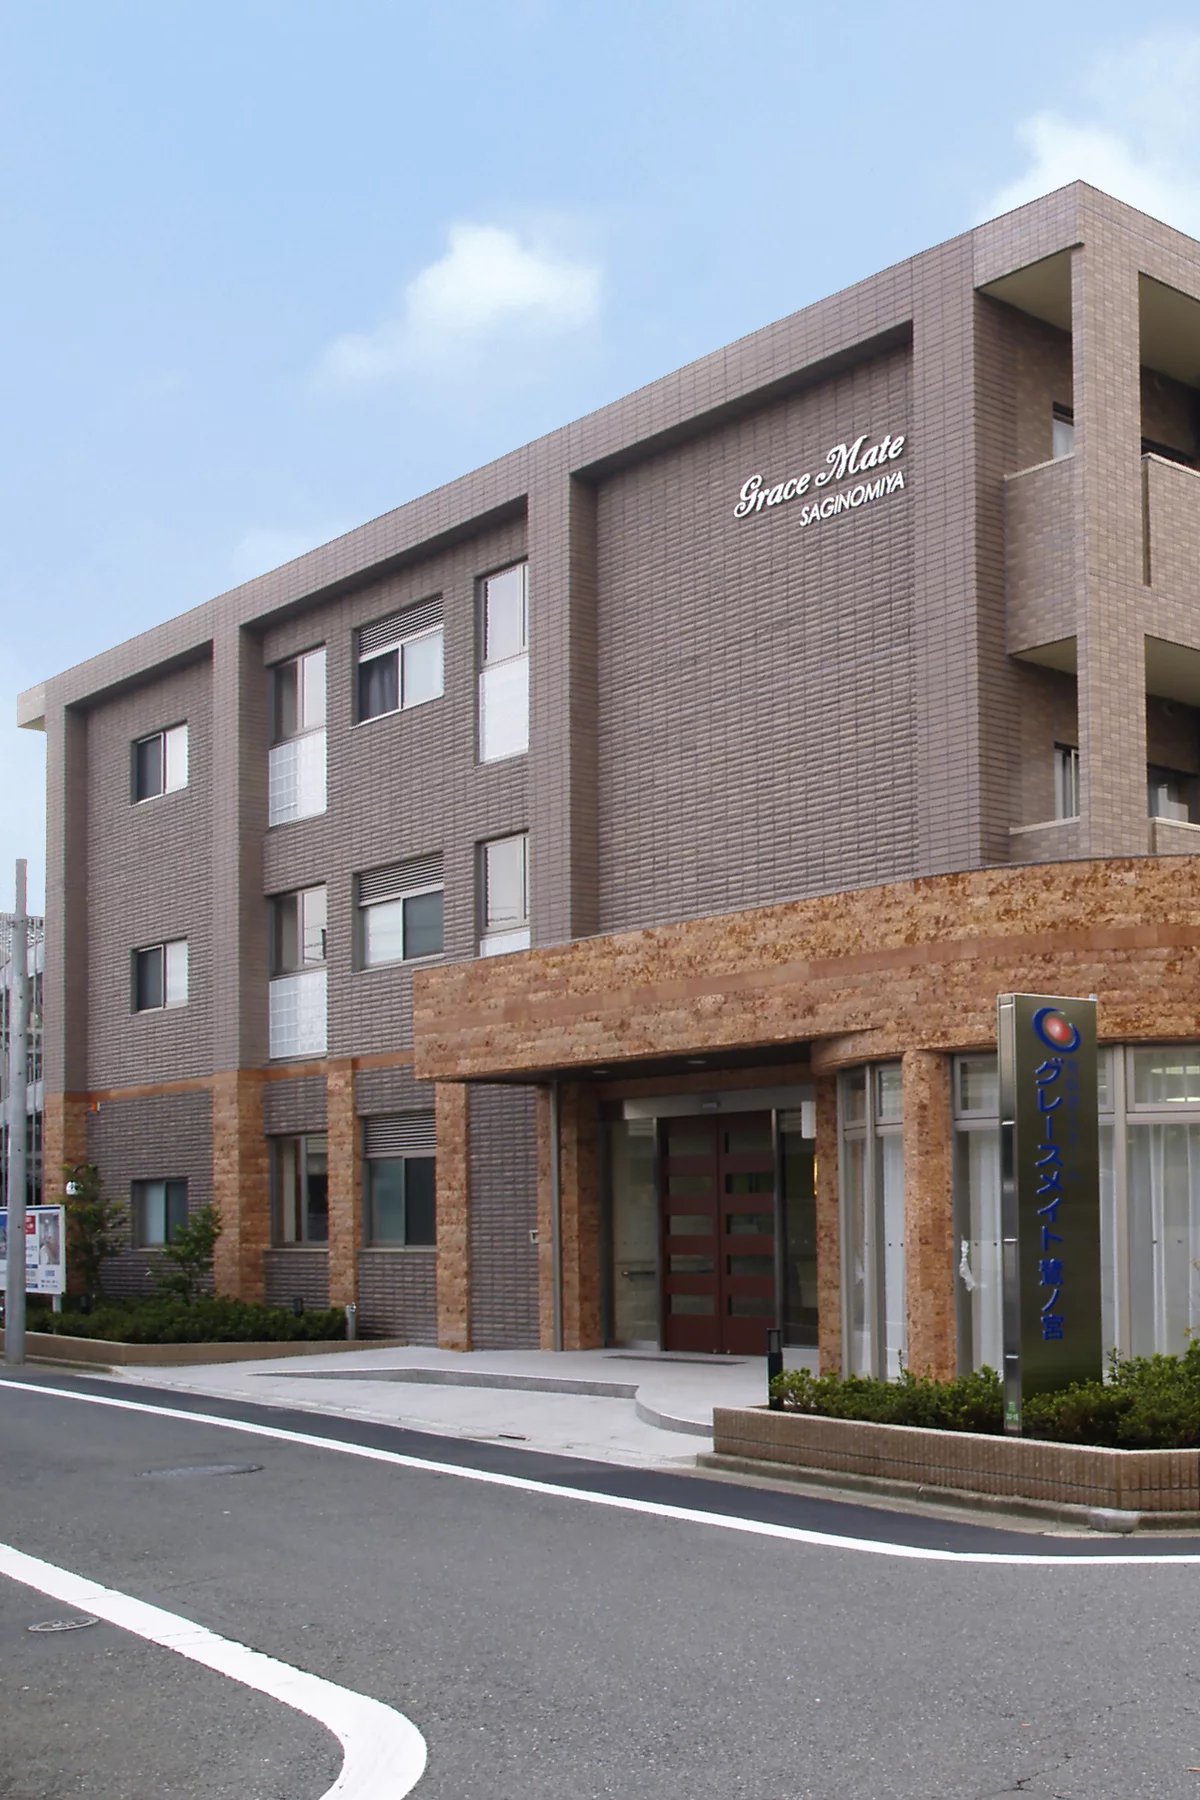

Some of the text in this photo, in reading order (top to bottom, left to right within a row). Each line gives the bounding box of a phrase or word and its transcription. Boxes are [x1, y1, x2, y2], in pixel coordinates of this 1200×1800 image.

[734, 434, 905, 518] Grace Mate
[800, 471, 904, 527] SAGINOMIYA
[1034, 1057, 1065, 1340] グレースメイト鷺ノ宮
